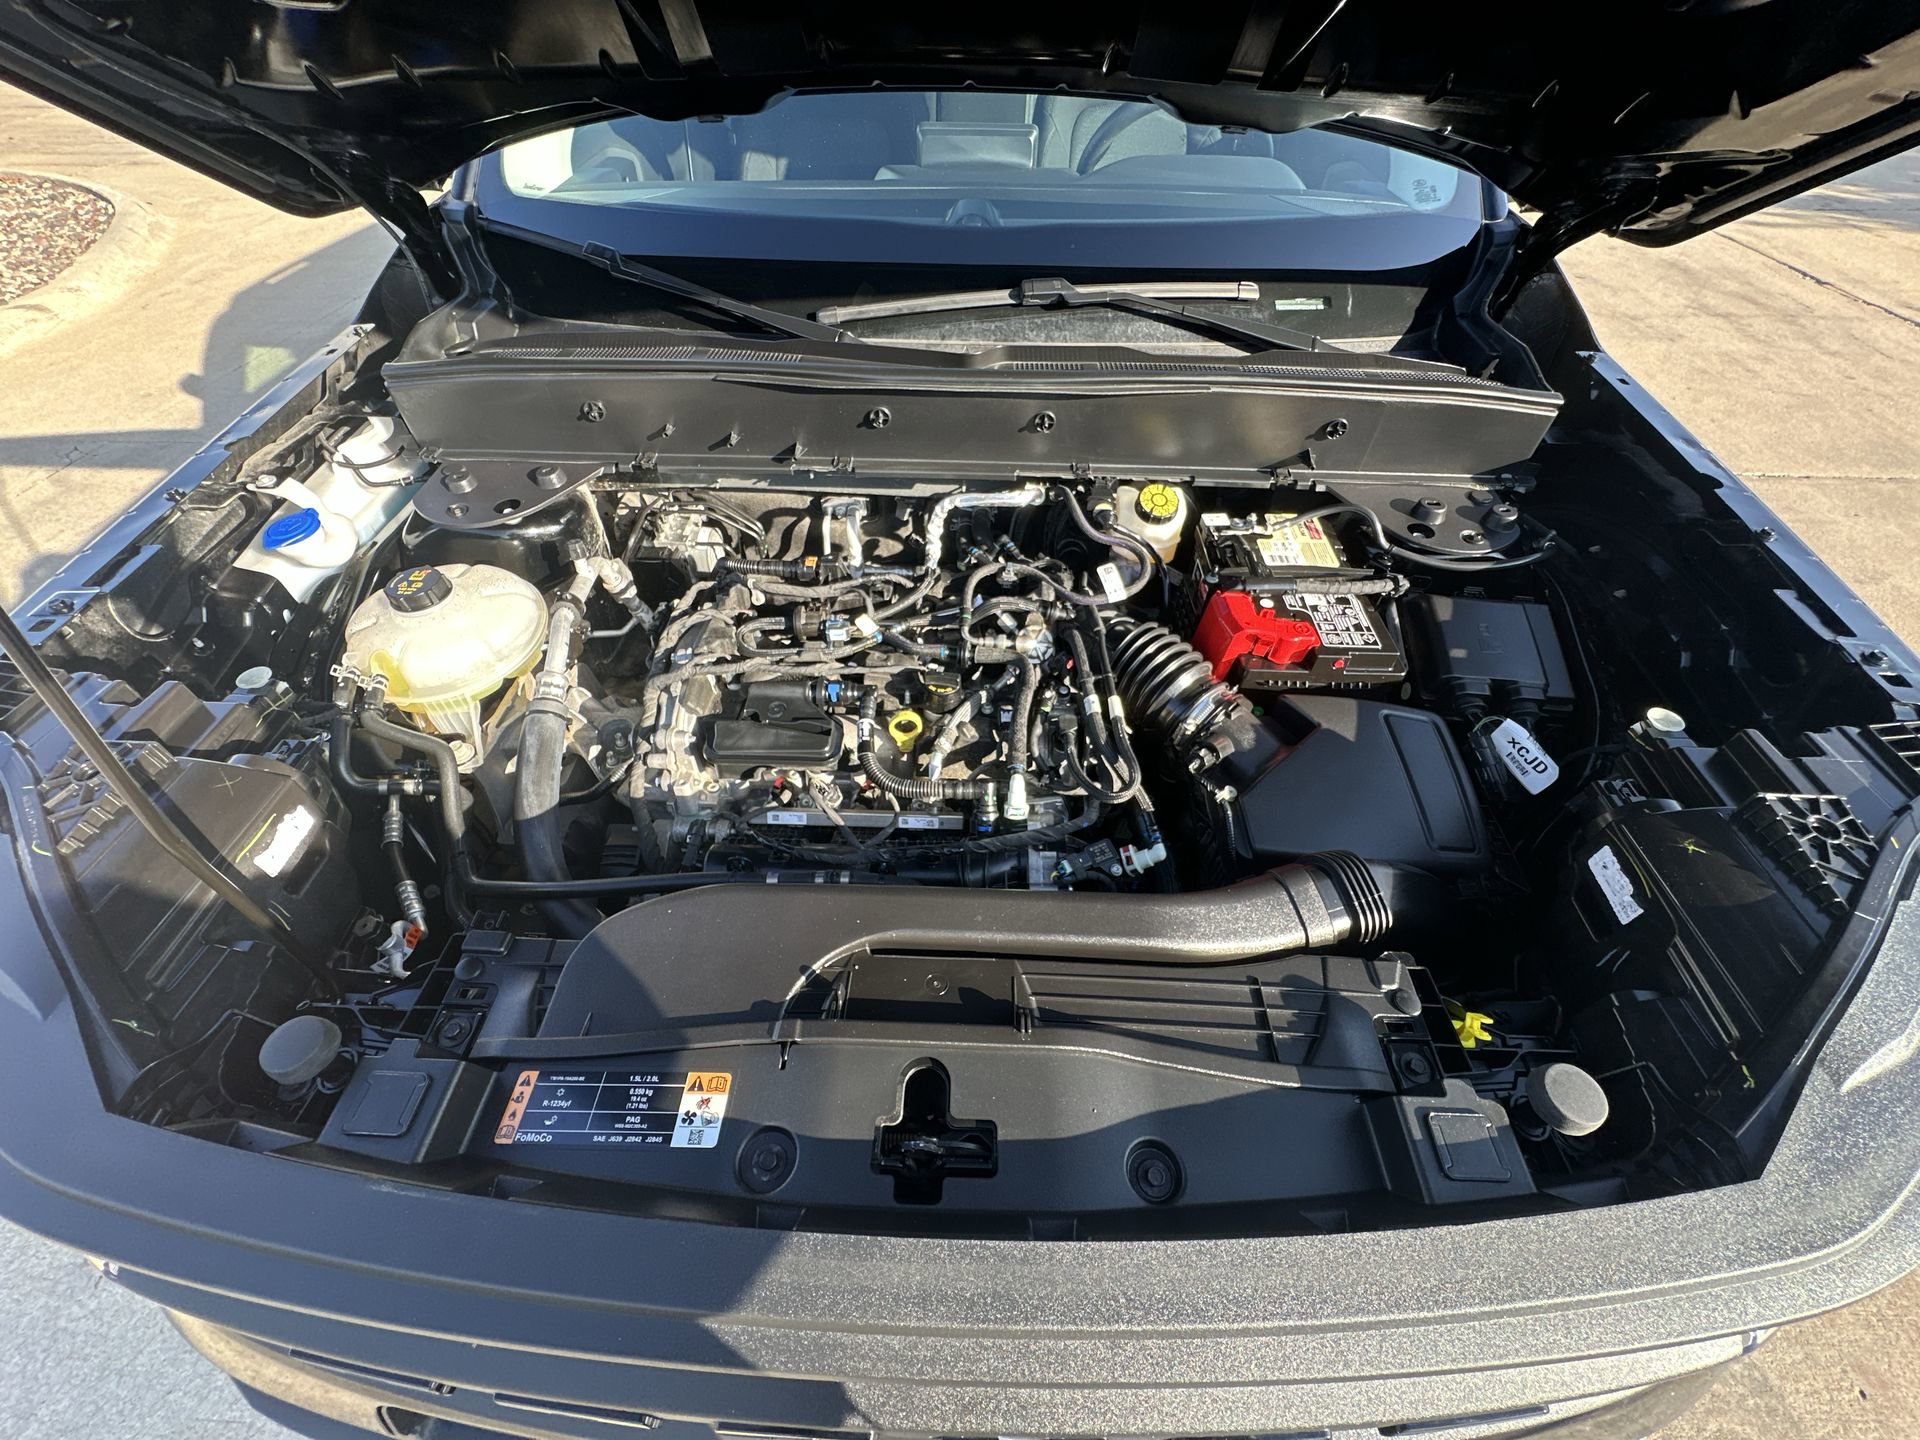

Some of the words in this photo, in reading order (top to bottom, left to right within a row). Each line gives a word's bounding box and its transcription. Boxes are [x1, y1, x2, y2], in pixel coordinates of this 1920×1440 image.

[645, 1088, 653, 1096] kg
[542, 1100, 571, 1108] R-1234yf
[515, 1133, 552, 1142] FoMoCo
